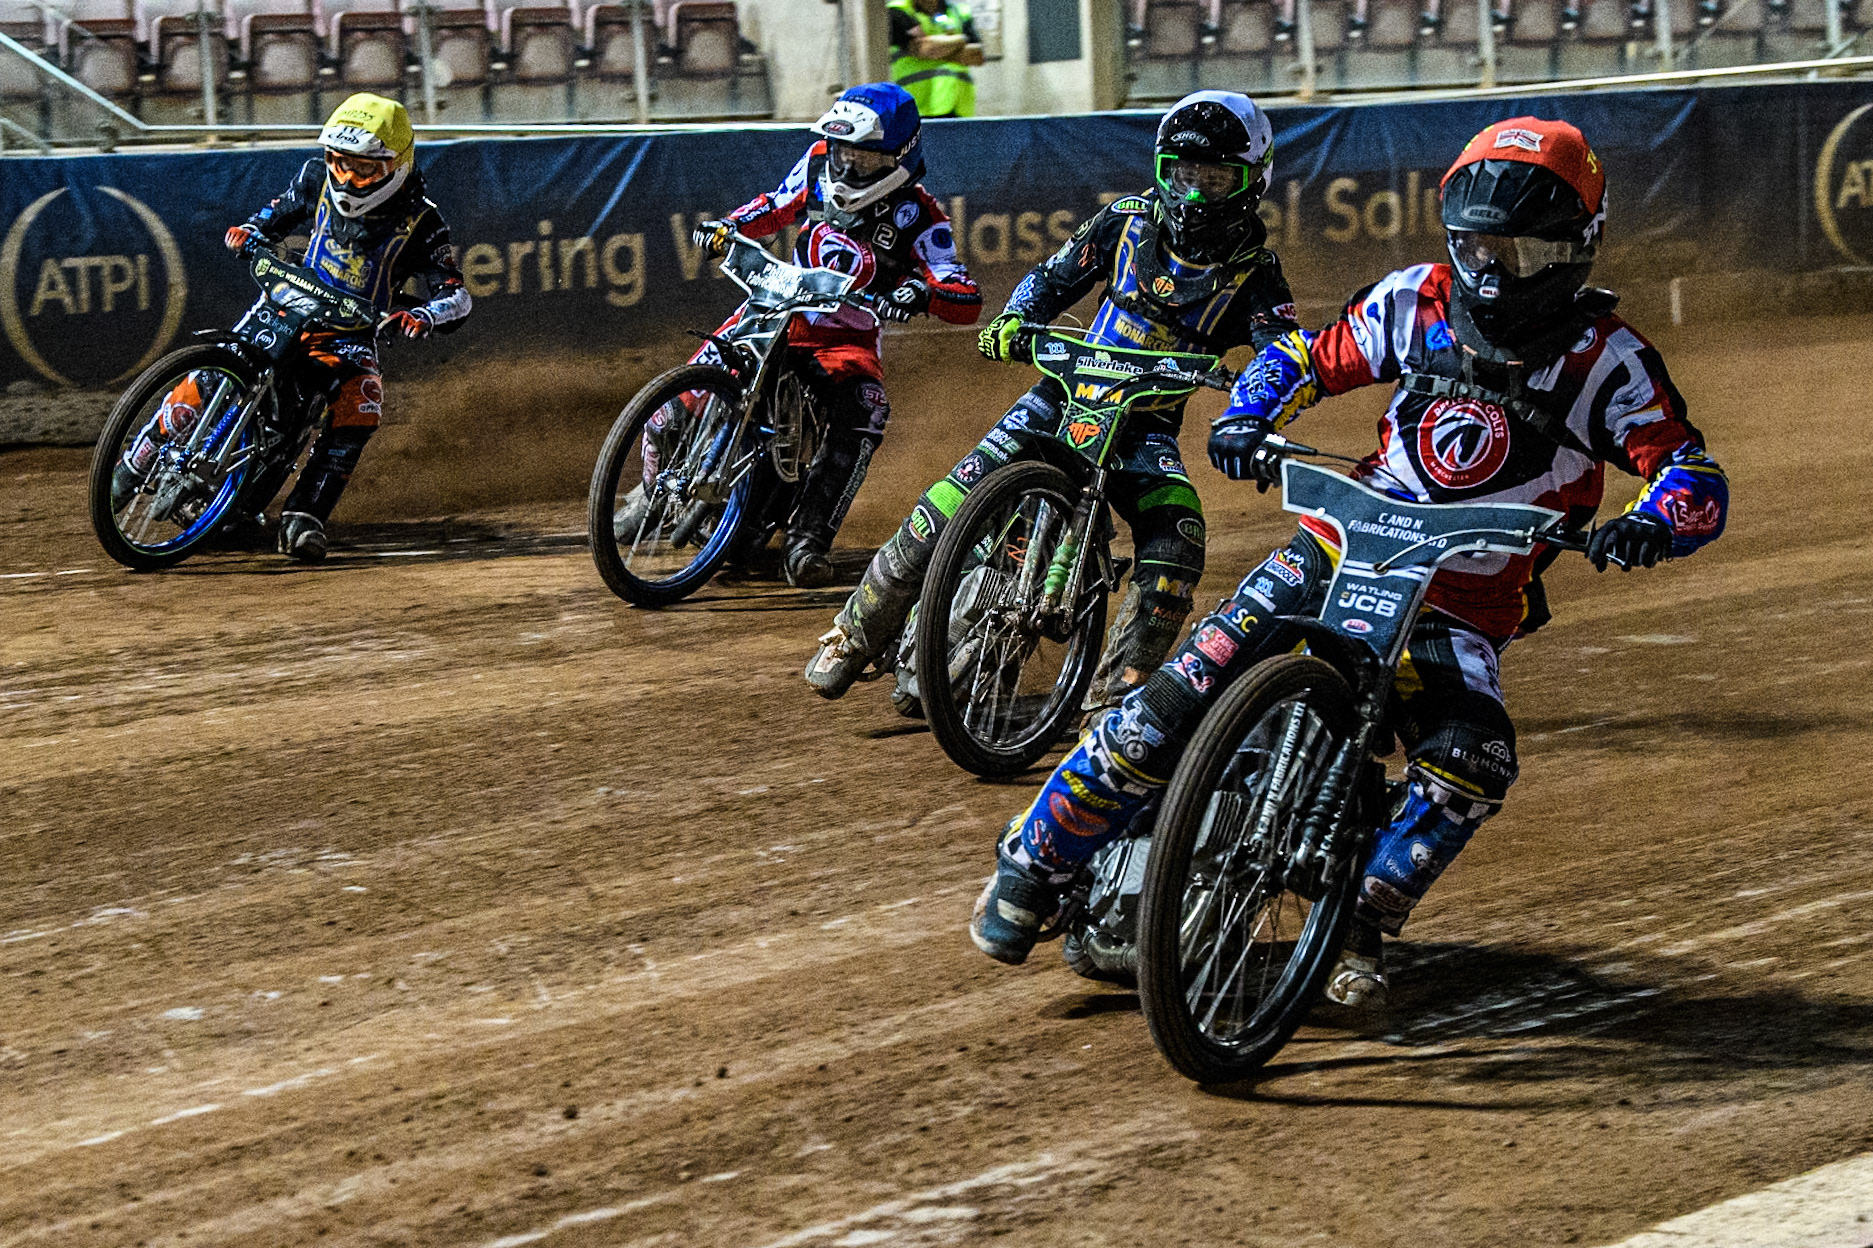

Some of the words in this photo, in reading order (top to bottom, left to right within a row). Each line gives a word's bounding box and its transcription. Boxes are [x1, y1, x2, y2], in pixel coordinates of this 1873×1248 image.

[951, 196, 1076, 264] lass
[29, 253, 151, 316] ATPI
[1076, 356, 1145, 376] Silverlake
[1485, 404, 1504, 438] COLTS
[1347, 519, 1426, 543] FABRICATIONS
[1379, 512, 1388, 523] C
[1387, 515, 1413, 528] AND
[1413, 519, 1424, 529] N
[1346, 582, 1403, 600] WATLING
[1338, 592, 1397, 618] JCB
